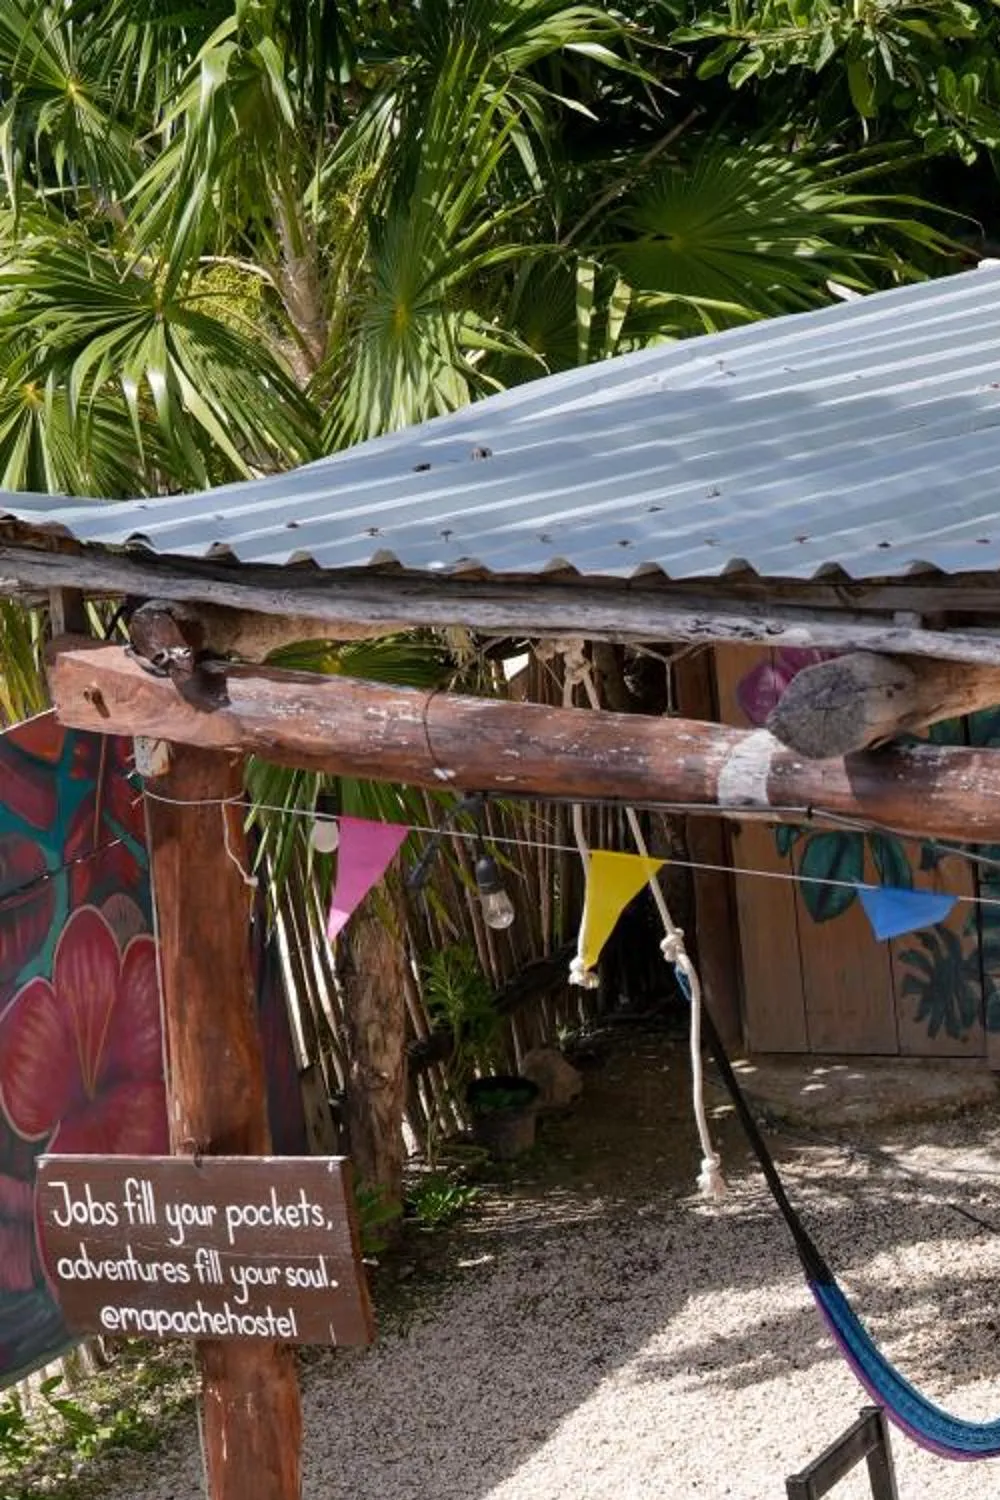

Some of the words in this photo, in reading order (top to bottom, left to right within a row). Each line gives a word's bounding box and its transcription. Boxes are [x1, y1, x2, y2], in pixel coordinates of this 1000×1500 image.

[48, 1181, 118, 1227] Jobs
[123, 1178, 156, 1225] fill
[165, 1204, 216, 1245] your
[226, 1186, 333, 1244] pockets,
[57, 1242, 190, 1283] adventures
[194, 1248, 223, 1285] fill
[231, 1265, 280, 1304] your
[285, 1255, 339, 1288] soul.
[100, 1301, 298, 1337] @mapachehostel
